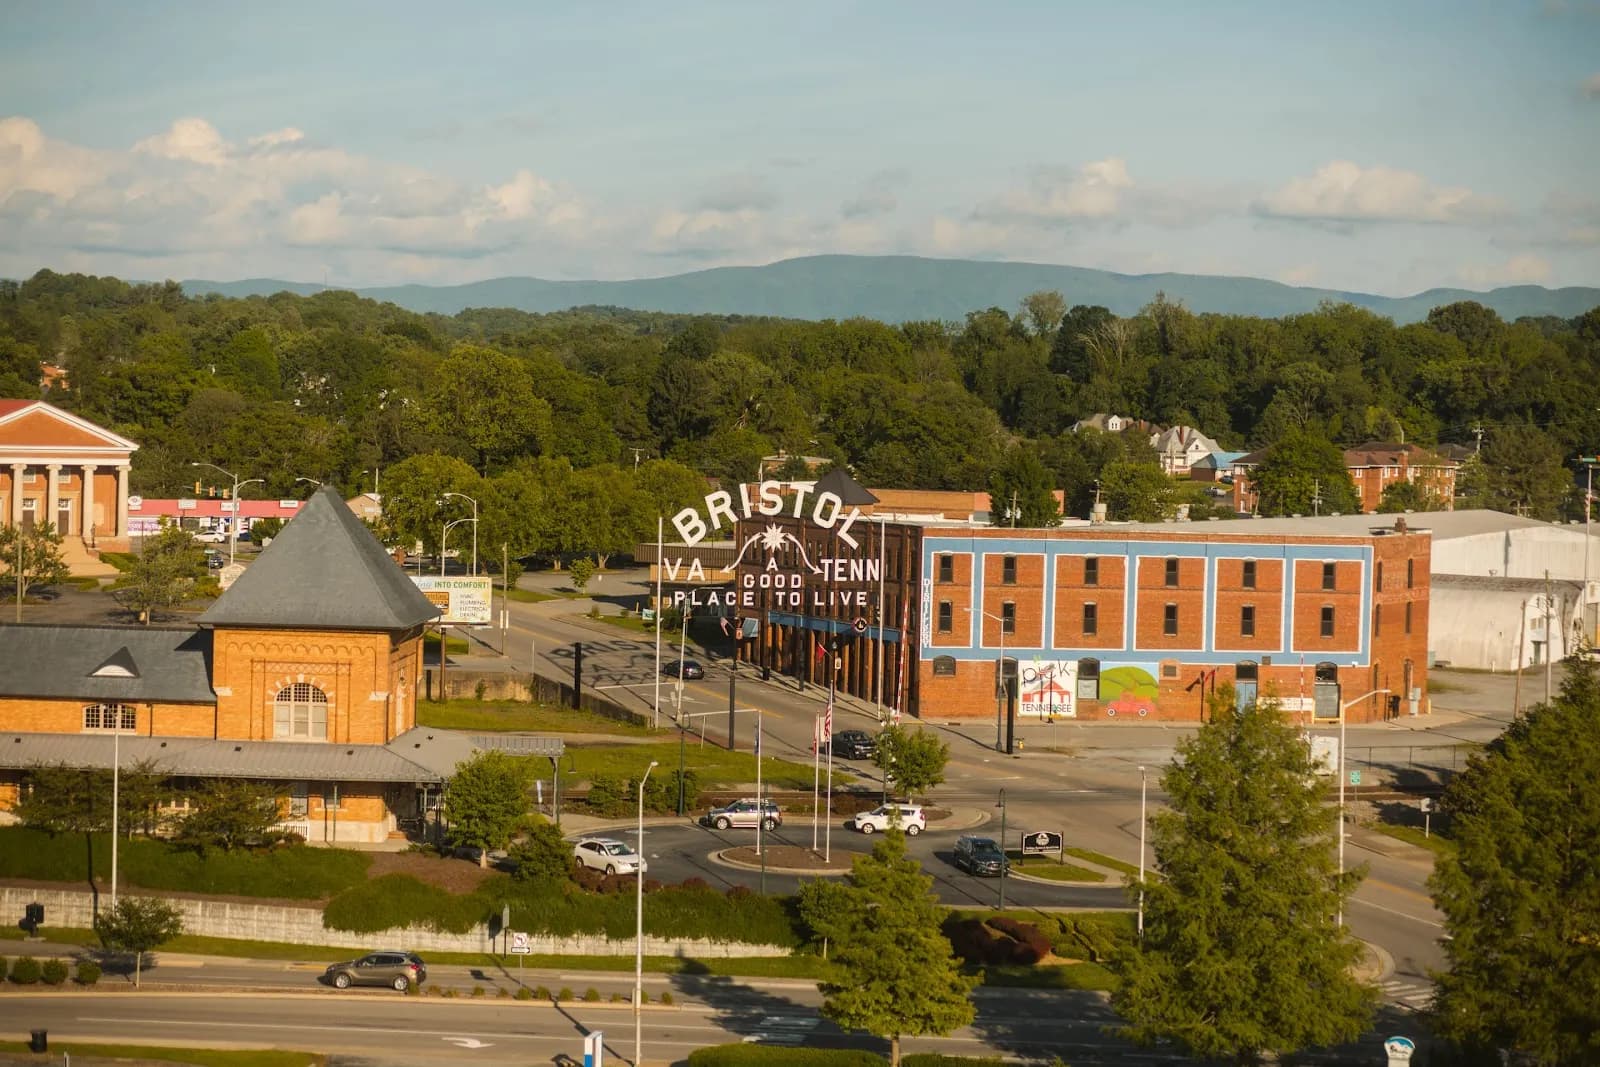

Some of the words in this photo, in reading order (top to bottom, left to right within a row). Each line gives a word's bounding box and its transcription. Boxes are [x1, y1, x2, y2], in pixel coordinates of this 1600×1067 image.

[671, 480, 861, 550] BRISTOL
[664, 557, 706, 581] VA
[820, 558, 880, 582] TENN
[766, 557, 779, 572] A
[434, 581, 452, 589] INTO
[743, 574, 802, 589] GOOD
[674, 591, 755, 606] PLACE
[775, 591, 801, 606] TO
[814, 591, 868, 606] LIVE
[1021, 703, 1072, 713] TENNESEE
